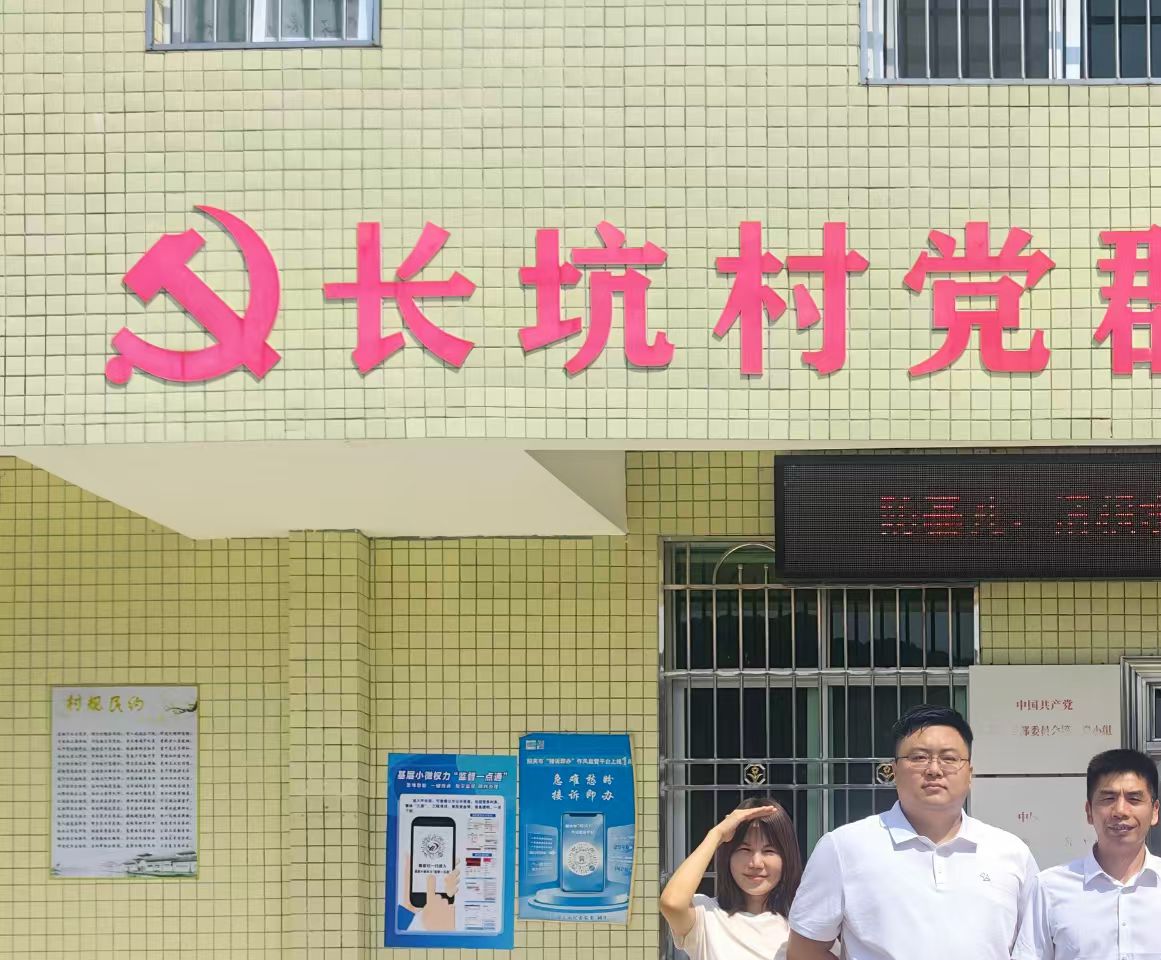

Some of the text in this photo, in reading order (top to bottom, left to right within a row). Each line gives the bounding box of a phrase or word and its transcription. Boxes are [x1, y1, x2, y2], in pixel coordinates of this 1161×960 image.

[1016, 699, 1073, 711] 中国共产党
[551, 789, 615, 802] 接诉即办
